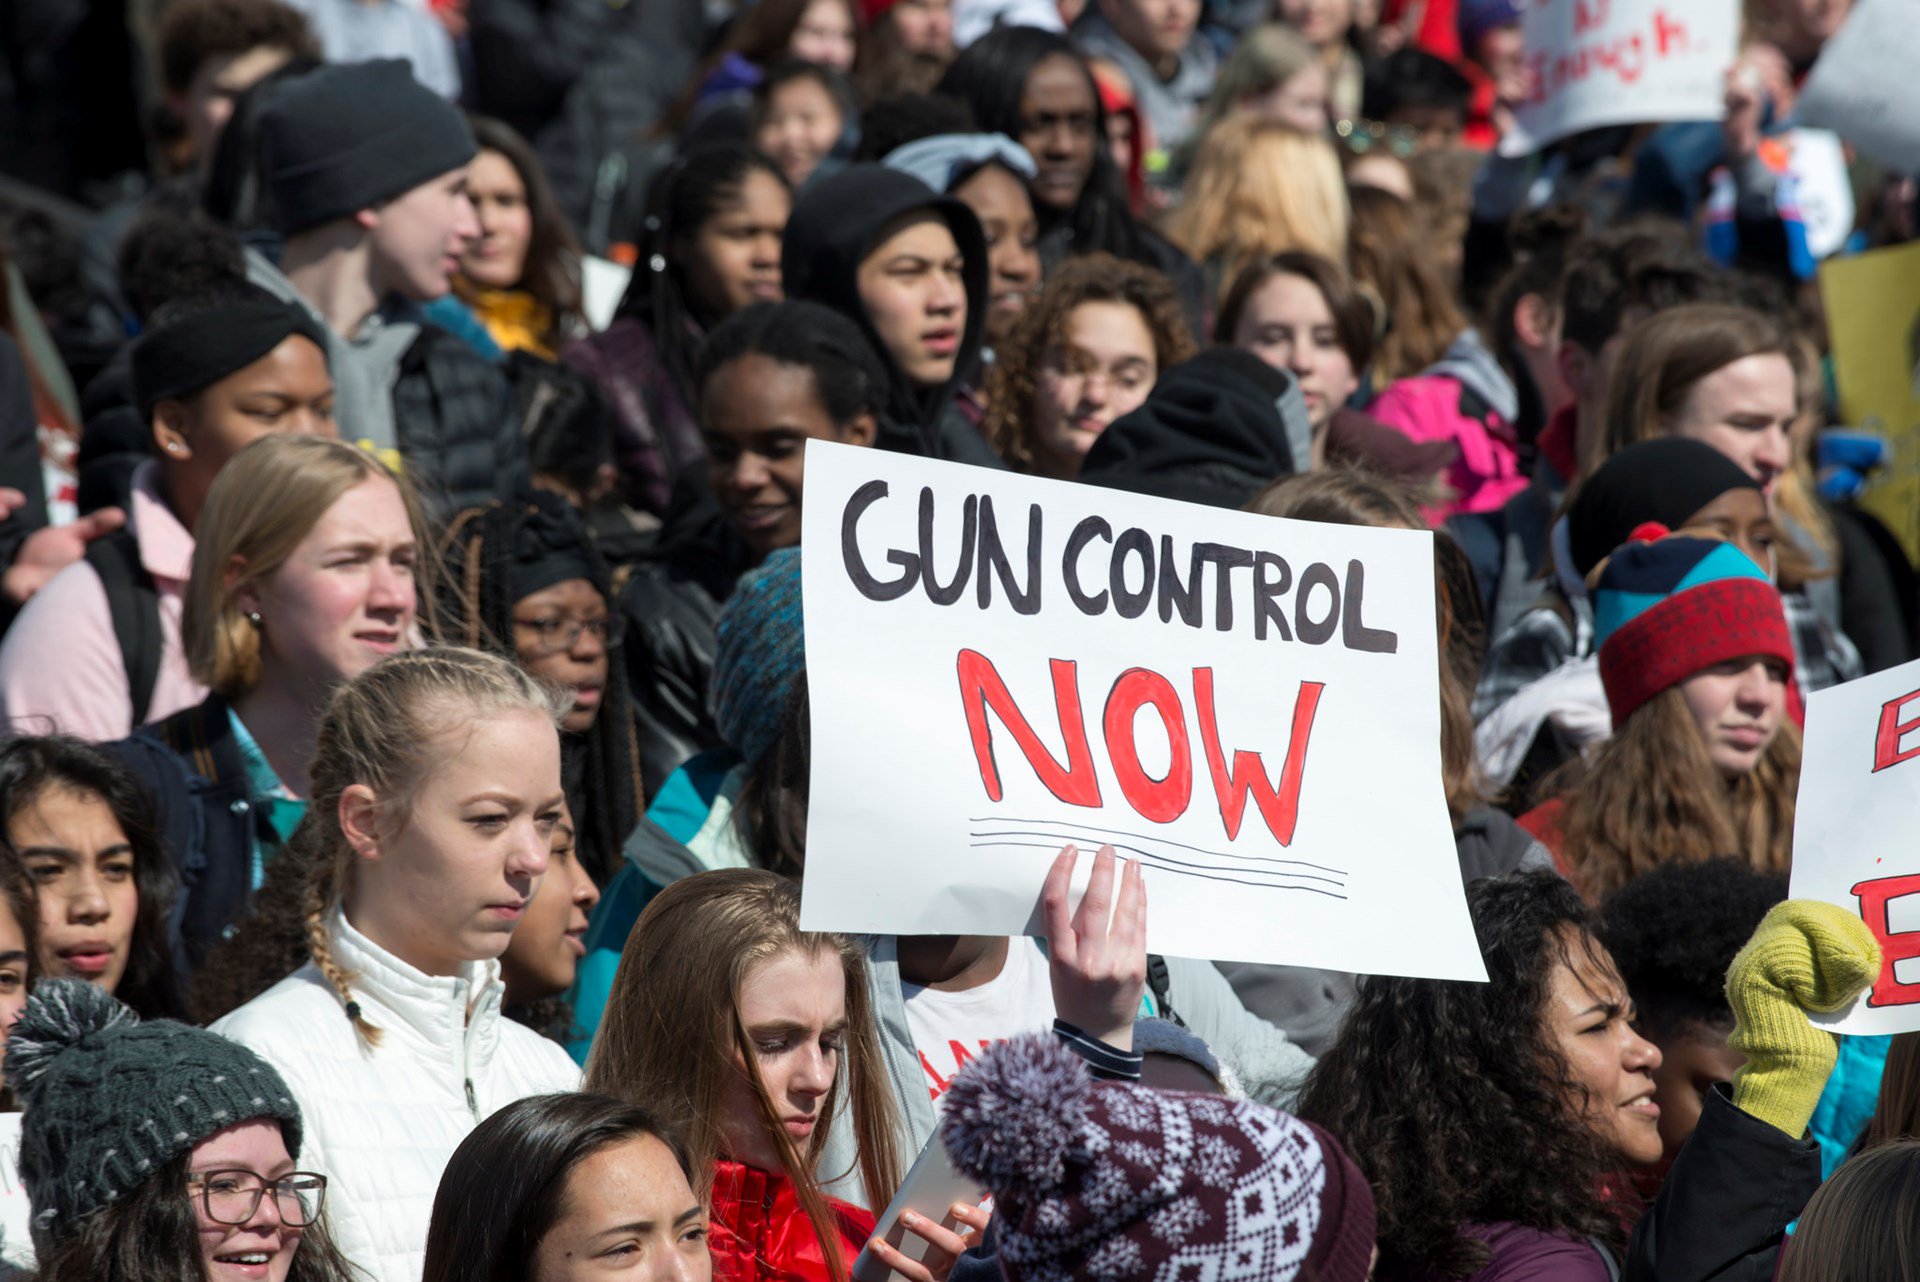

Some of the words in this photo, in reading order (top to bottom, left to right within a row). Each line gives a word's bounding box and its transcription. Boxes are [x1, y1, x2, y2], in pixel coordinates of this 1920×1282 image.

[841, 479, 1043, 616] GUN
[1061, 514, 1398, 654] CONTROL
[956, 648, 1327, 848] NOW
